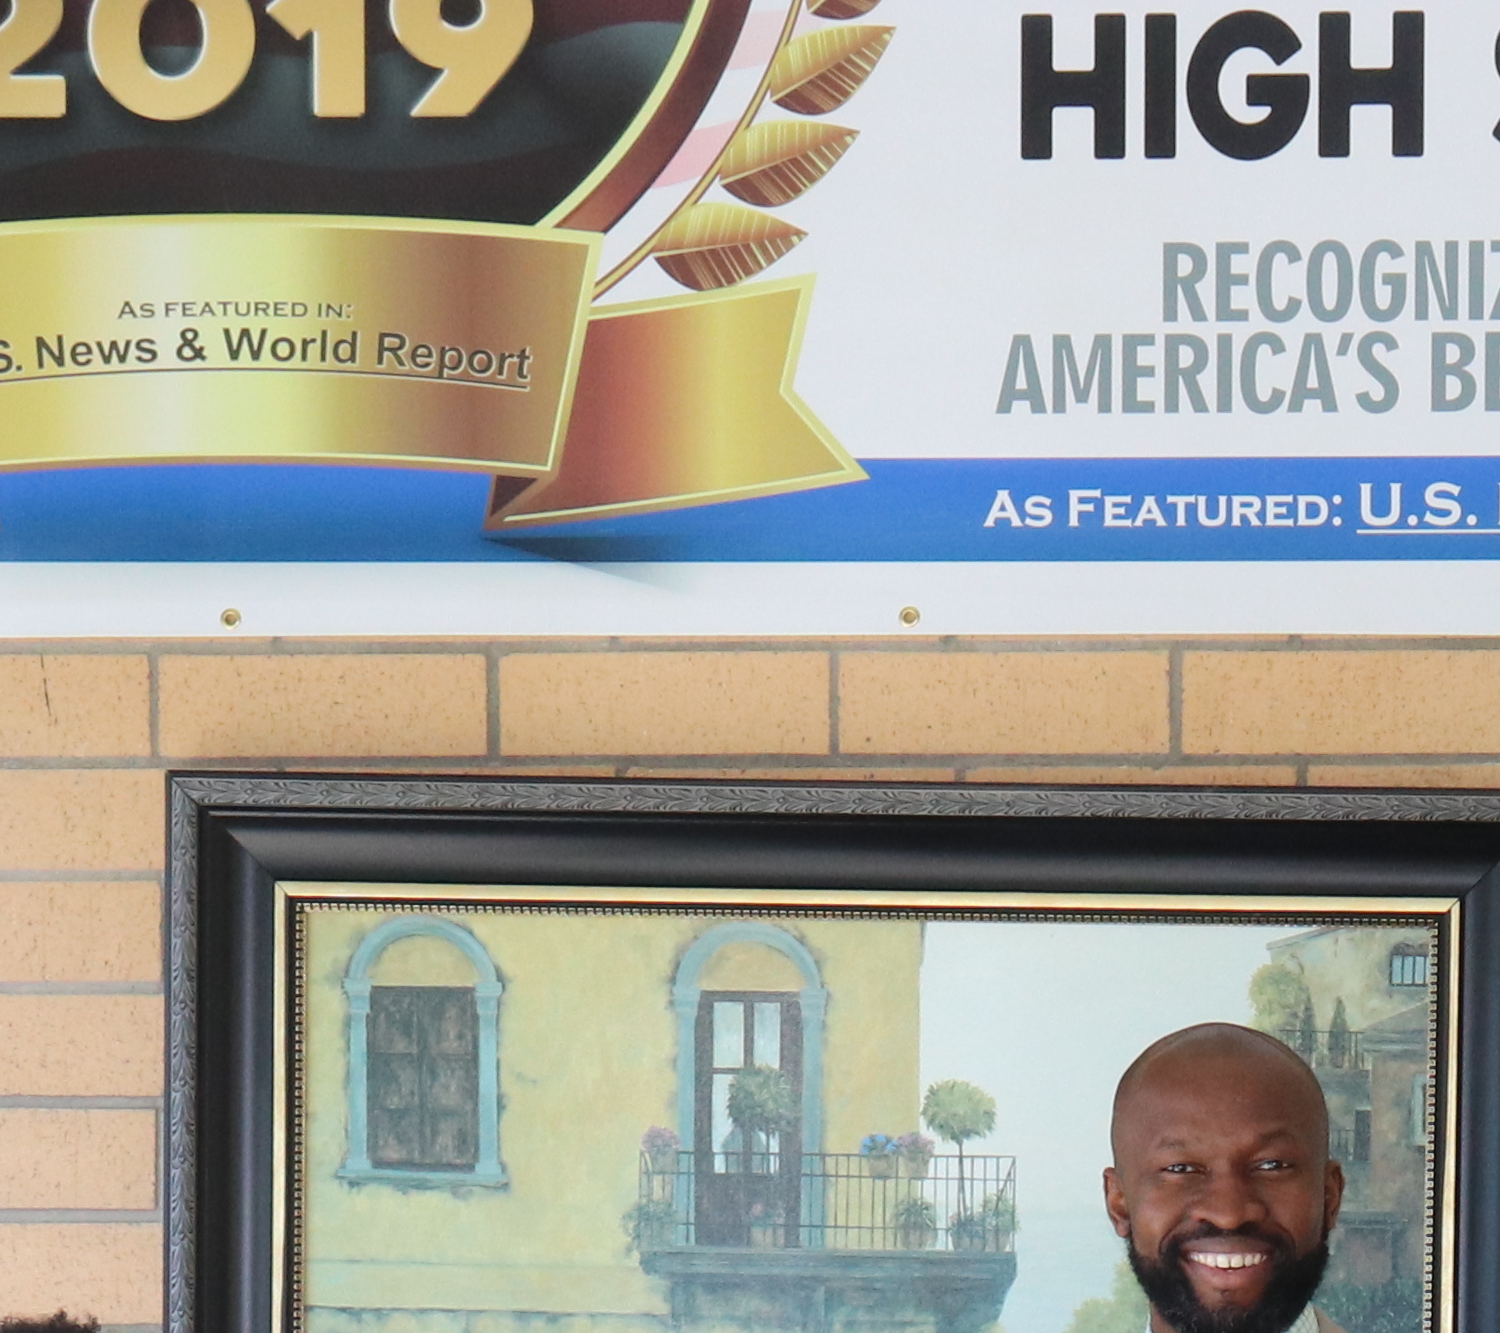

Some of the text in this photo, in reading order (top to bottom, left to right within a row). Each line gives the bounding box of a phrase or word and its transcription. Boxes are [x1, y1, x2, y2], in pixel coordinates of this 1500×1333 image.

[1019, 8, 1426, 161] HIGH
[163, 300, 309, 319] FEATURED
[316, 302, 353, 320] IN:
[35, 331, 158, 370] News
[174, 326, 208, 363] &
[222, 326, 358, 365] World
[376, 331, 532, 381] Report
[994, 331, 1400, 416] AMERICA'S
[1067, 487, 1344, 530] FEATURED:
[1357, 484, 1479, 528] U.S.
